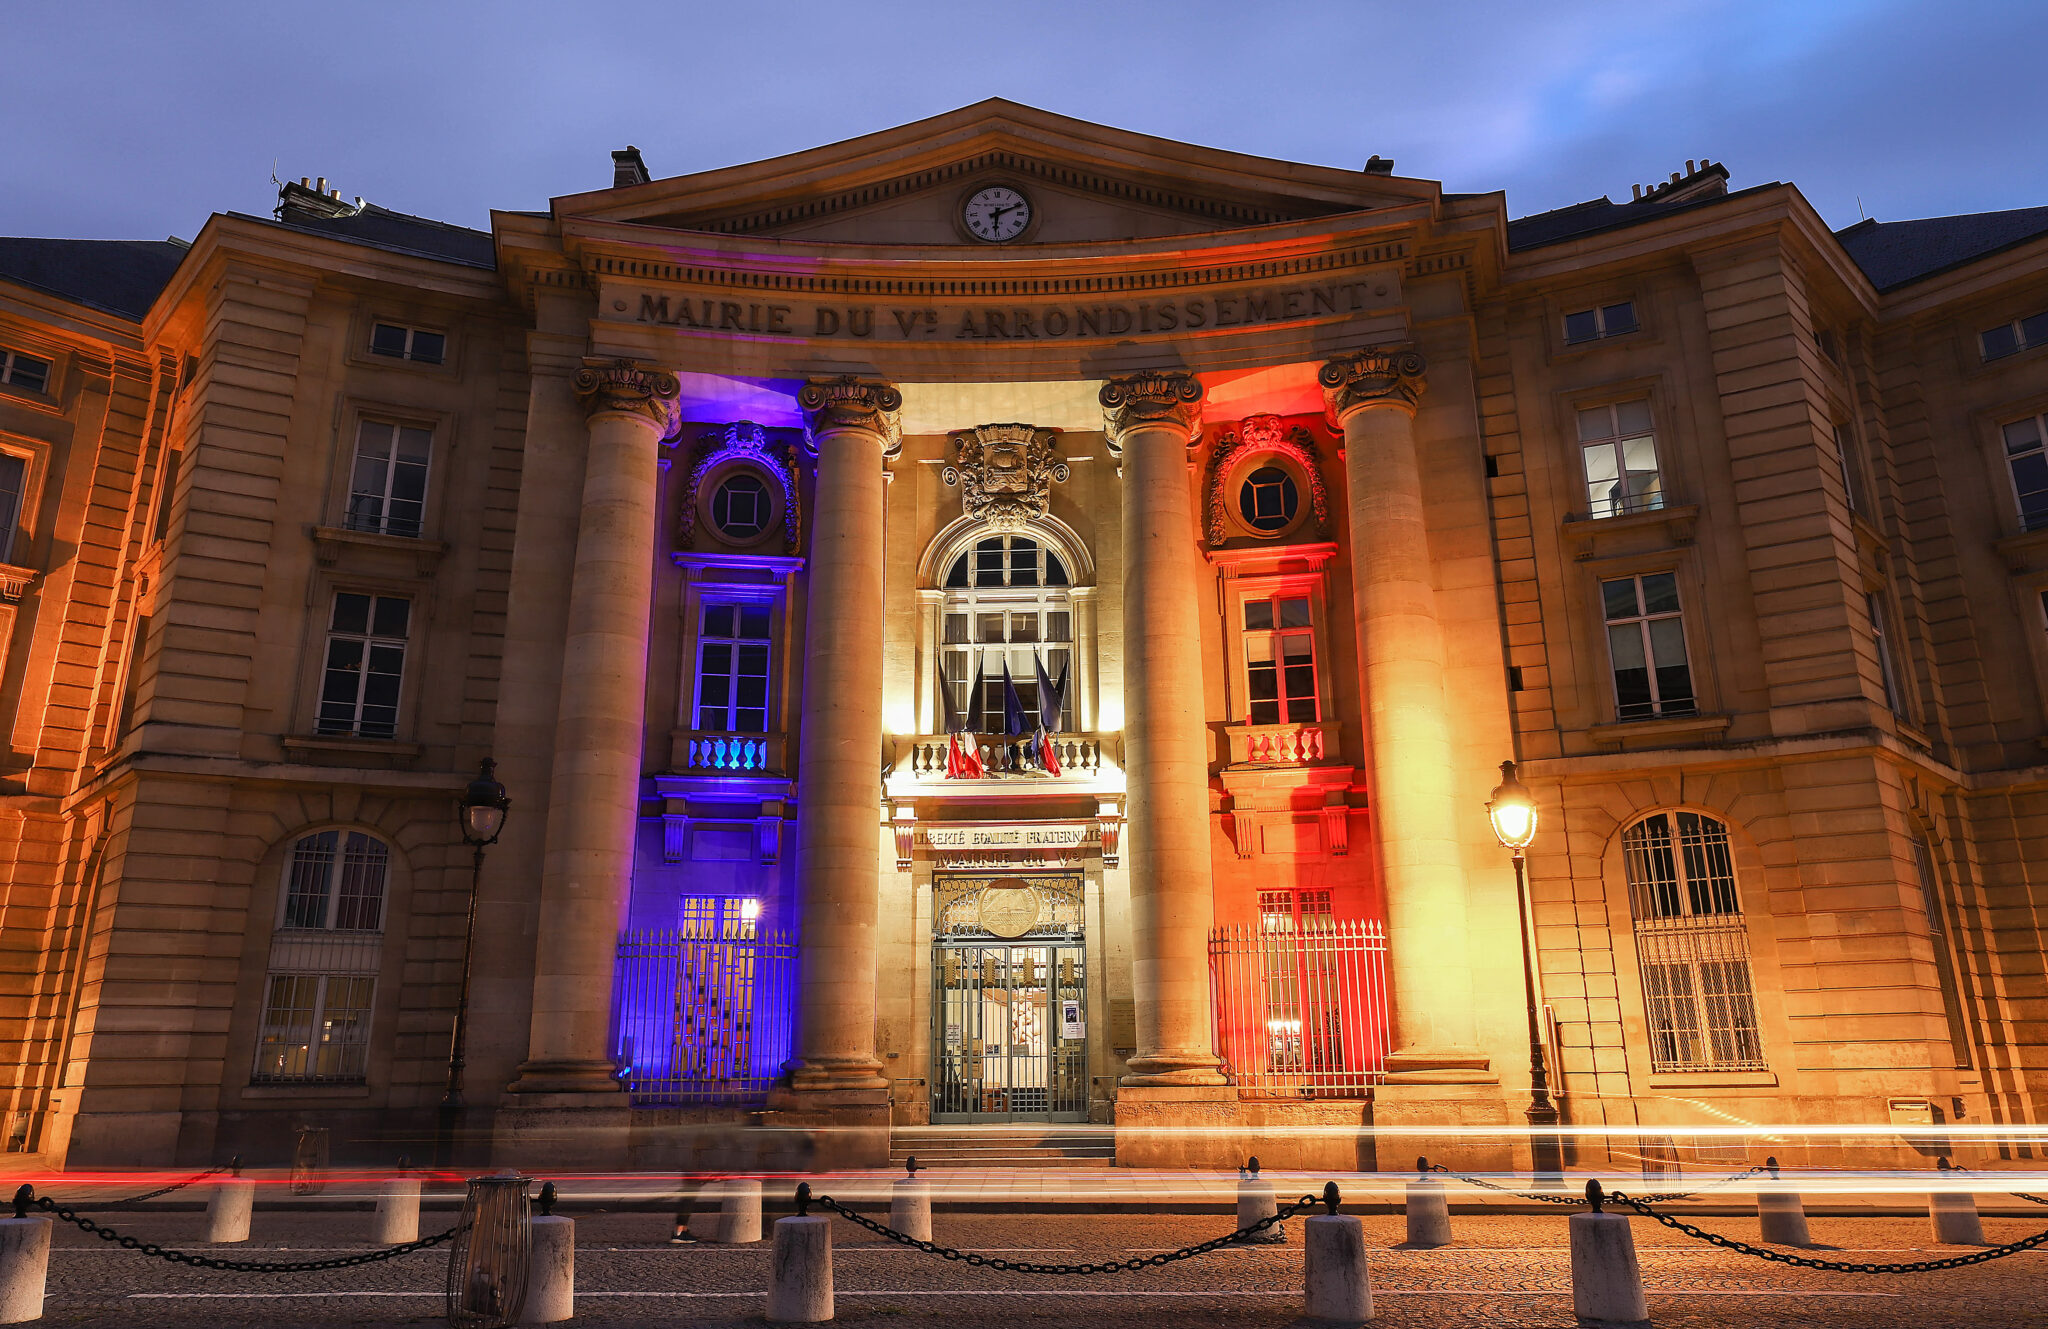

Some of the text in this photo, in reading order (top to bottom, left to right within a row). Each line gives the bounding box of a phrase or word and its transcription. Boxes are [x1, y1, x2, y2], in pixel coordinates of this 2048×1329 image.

[636, 293, 793, 334] MAIRIE
[814, 307, 874, 337] DU
[955, 282, 1368, 339] ARRONDISSEMENT
[934, 850, 1081, 869] MAIRIE du Ve
